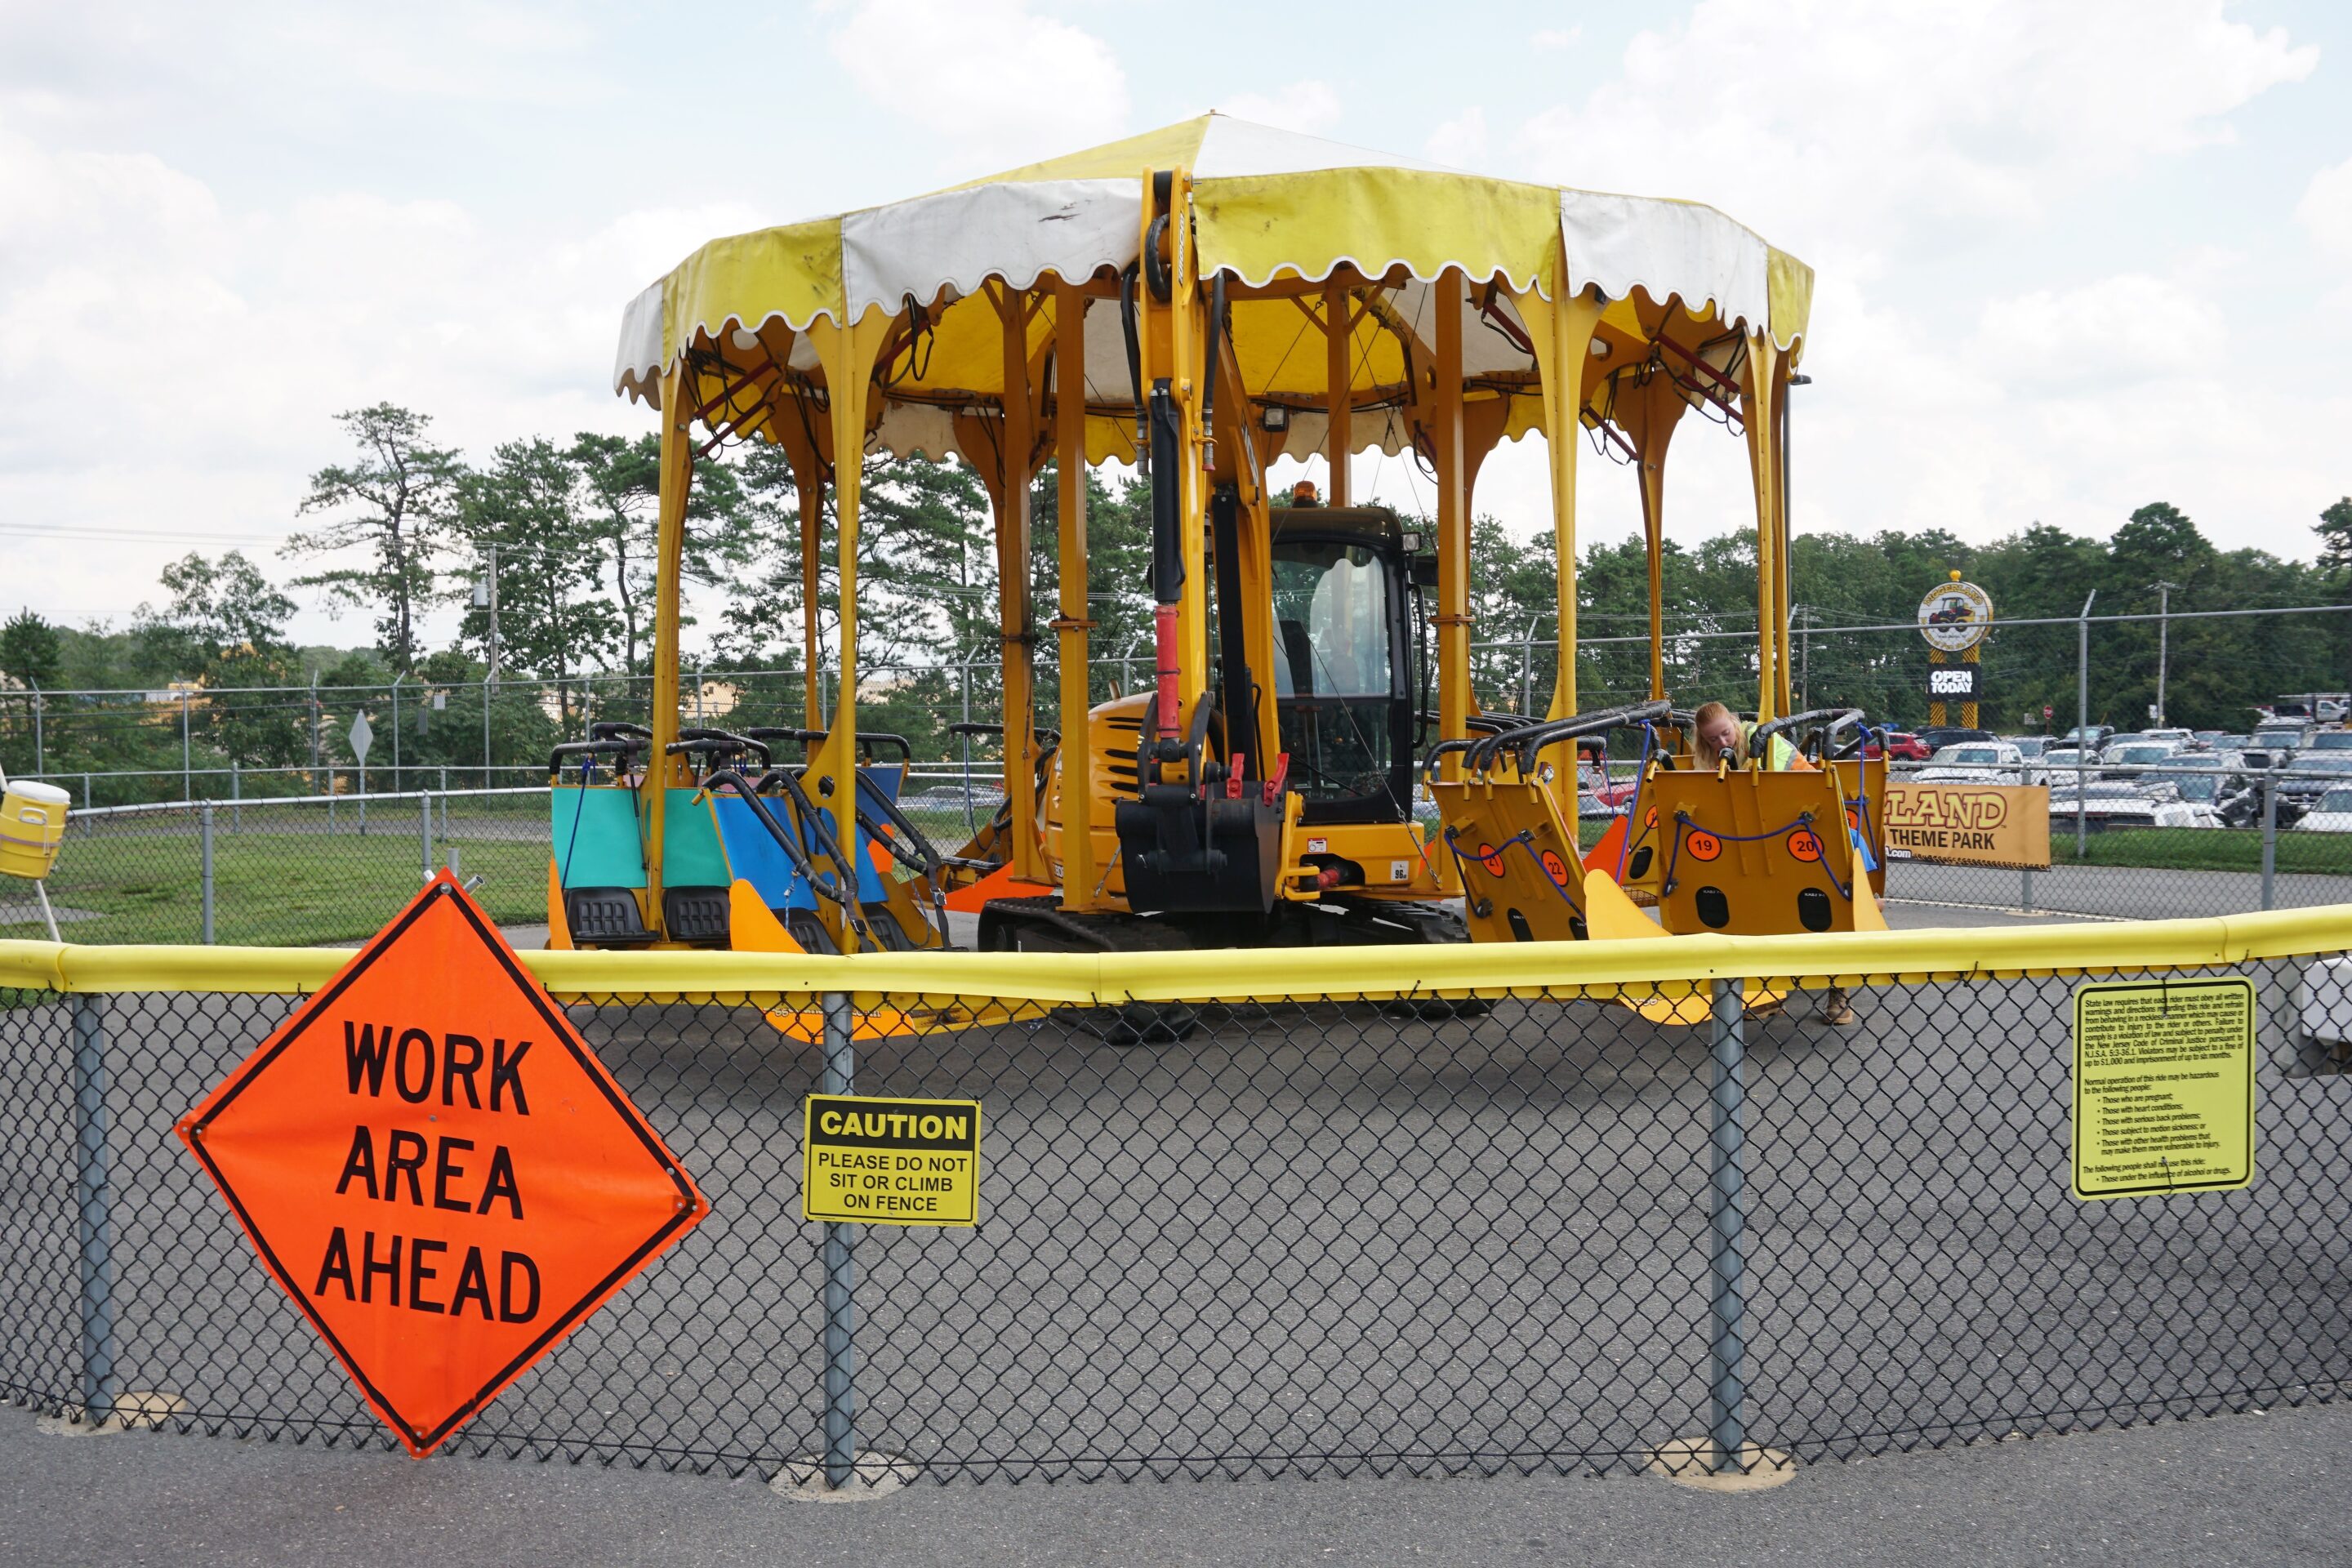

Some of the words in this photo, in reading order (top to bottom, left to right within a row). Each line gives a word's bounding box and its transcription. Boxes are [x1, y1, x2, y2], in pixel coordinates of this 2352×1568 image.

[1923, 584, 1983, 606] DIGGERLAND
[1931, 670, 1973, 682] OPEN
[1931, 682, 1973, 693] TODAY
[1695, 840, 1713, 851] 19
[1796, 840, 1815, 852] 20
[1889, 828, 1949, 848] THEME
[1952, 831, 1995, 850] PARK
[1548, 862, 1563, 875] 22
[2085, 1000, 2100, 1008] State
[2103, 999, 2113, 1007] law
[2114, 998, 2138, 1008] requires
[2170, 996, 2182, 1004] rider
[2185, 995, 2198, 1003] must
[2201, 994, 2213, 1004] obey
[2224, 992, 2243, 1000] written
[2085, 1008, 2111, 1018] warnings
[2114, 1007, 2124, 1015] and
[2127, 1005, 2155, 1014] directions
[2212, 1002, 2222, 1010] and
[2225, 1001, 2243, 1009] refrain
[2085, 1025, 2115, 1034] contribute
[2127, 1023, 2143, 1033] injury
[2216, 1018, 2234, 1027] Failure
[2100, 1016, 2127, 1026] behaving
[2140, 1014, 2163, 1022] reckless
[2189, 1012, 2205, 1020] which
[2207, 1013, 2217, 1021] may
[2085, 1034, 2105, 1044] comply
[2107, 1033, 2111, 1041] is
[2118, 1031, 2142, 1040] violation
[2151, 1031, 2160, 1039] law
[2163, 1030, 2174, 1038] and
[2175, 1029, 2196, 1039] subject
[2204, 1027, 2225, 1037] penalty
[2227, 1027, 2243, 1035] under
[2097, 1042, 2109, 1050] New
[2112, 1041, 2130, 1051] Jersey
[2133, 1040, 2148, 1048] Code
[2159, 1038, 2183, 1046] Criminal
[2186, 1037, 2206, 1045] Justice
[2208, 1036, 2234, 1045] pursuant
[2138, 1047, 2163, 1056] Violators
[2166, 1048, 2177, 1056] may
[2188, 1045, 2209, 1054] subject
[2100, 1058, 2123, 1067] $1,000
[2136, 1055, 2176, 1066] imprisonment
[344, 1021, 533, 1116] WORK
[2084, 1077, 2106, 1086] Normal
[2107, 1076, 2135, 1086] operation
[2143, 1075, 2154, 1083] this
[2155, 1074, 2166, 1082] ride
[2167, 1075, 2179, 1083] may
[2189, 1071, 2219, 1080] hazardous
[2102, 1085, 2128, 1096] following
[2102, 1097, 2119, 1105] Those
[2102, 1107, 2119, 1116] Those
[2134, 1105, 2150, 1113] heart
[820, 1111, 968, 1140] CAUTION
[2102, 1118, 2118, 1126] Those
[2134, 1116, 2154, 1124] serious
[2156, 1115, 2170, 1123] back
[2101, 1128, 2118, 1137] Those
[2120, 1127, 2141, 1137] subject
[2149, 1125, 2170, 1134] motion
[2101, 1139, 2118, 1147] Those
[2120, 1138, 2132, 1146] with
[2133, 1137, 2149, 1145] other
[2149, 1135, 2169, 1144] health
[2170, 1134, 2197, 1144] problems
[2198, 1133, 2210, 1141] that
[2101, 1149, 2113, 1157] may
[2114, 1147, 2131, 1155] make
[2132, 1145, 2147, 1153] them
[2164, 1143, 2194, 1152] vulnerable
[818, 1152, 889, 1170] PLEASE
[896, 1156, 923, 1171] DO
[929, 1157, 968, 1172] NOT
[2083, 1165, 2093, 1174] The
[2095, 1164, 2121, 1174] following
[2122, 1162, 2141, 1173] people
[2143, 1161, 2156, 1169] shall
[2180, 1159, 2191, 1167] this
[335, 1125, 524, 1220] AREA
[2101, 1174, 2118, 1183] Those
[2119, 1174, 2136, 1182] under
[2184, 1169, 2205, 1177] alcohol
[830, 1173, 858, 1188] SIT
[863, 1175, 889, 1190] OR
[895, 1177, 953, 1192] CLIMB
[844, 1194, 870, 1209] ON
[876, 1196, 938, 1211] FENCE
[314, 1227, 541, 1324] AHEAD
